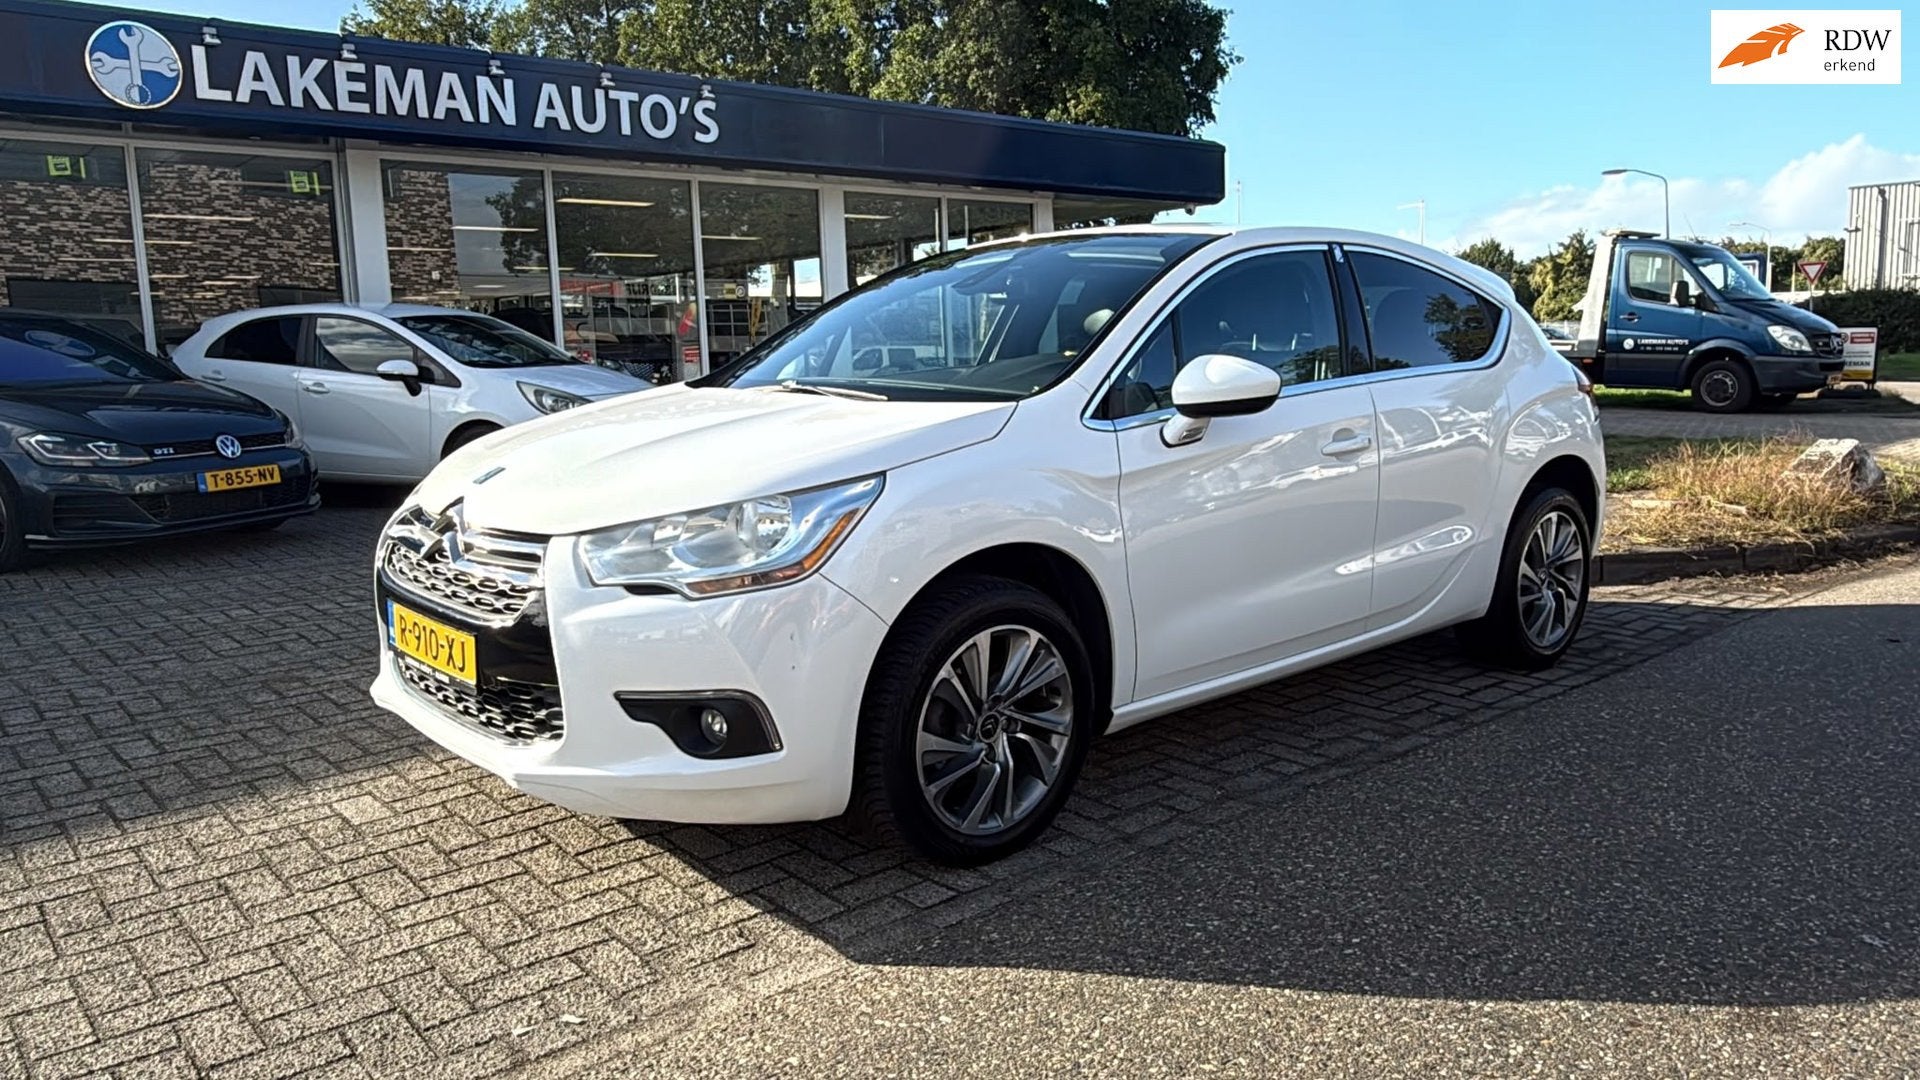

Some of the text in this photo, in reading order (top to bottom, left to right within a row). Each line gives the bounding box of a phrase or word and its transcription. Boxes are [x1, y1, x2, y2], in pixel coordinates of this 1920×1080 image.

[191, 44, 720, 144] LAKEMAN AUTO'S
[153, 447, 175, 455] GTI
[210, 466, 276, 489] T-855-NV
[399, 613, 466, 673] R-910-XJ
